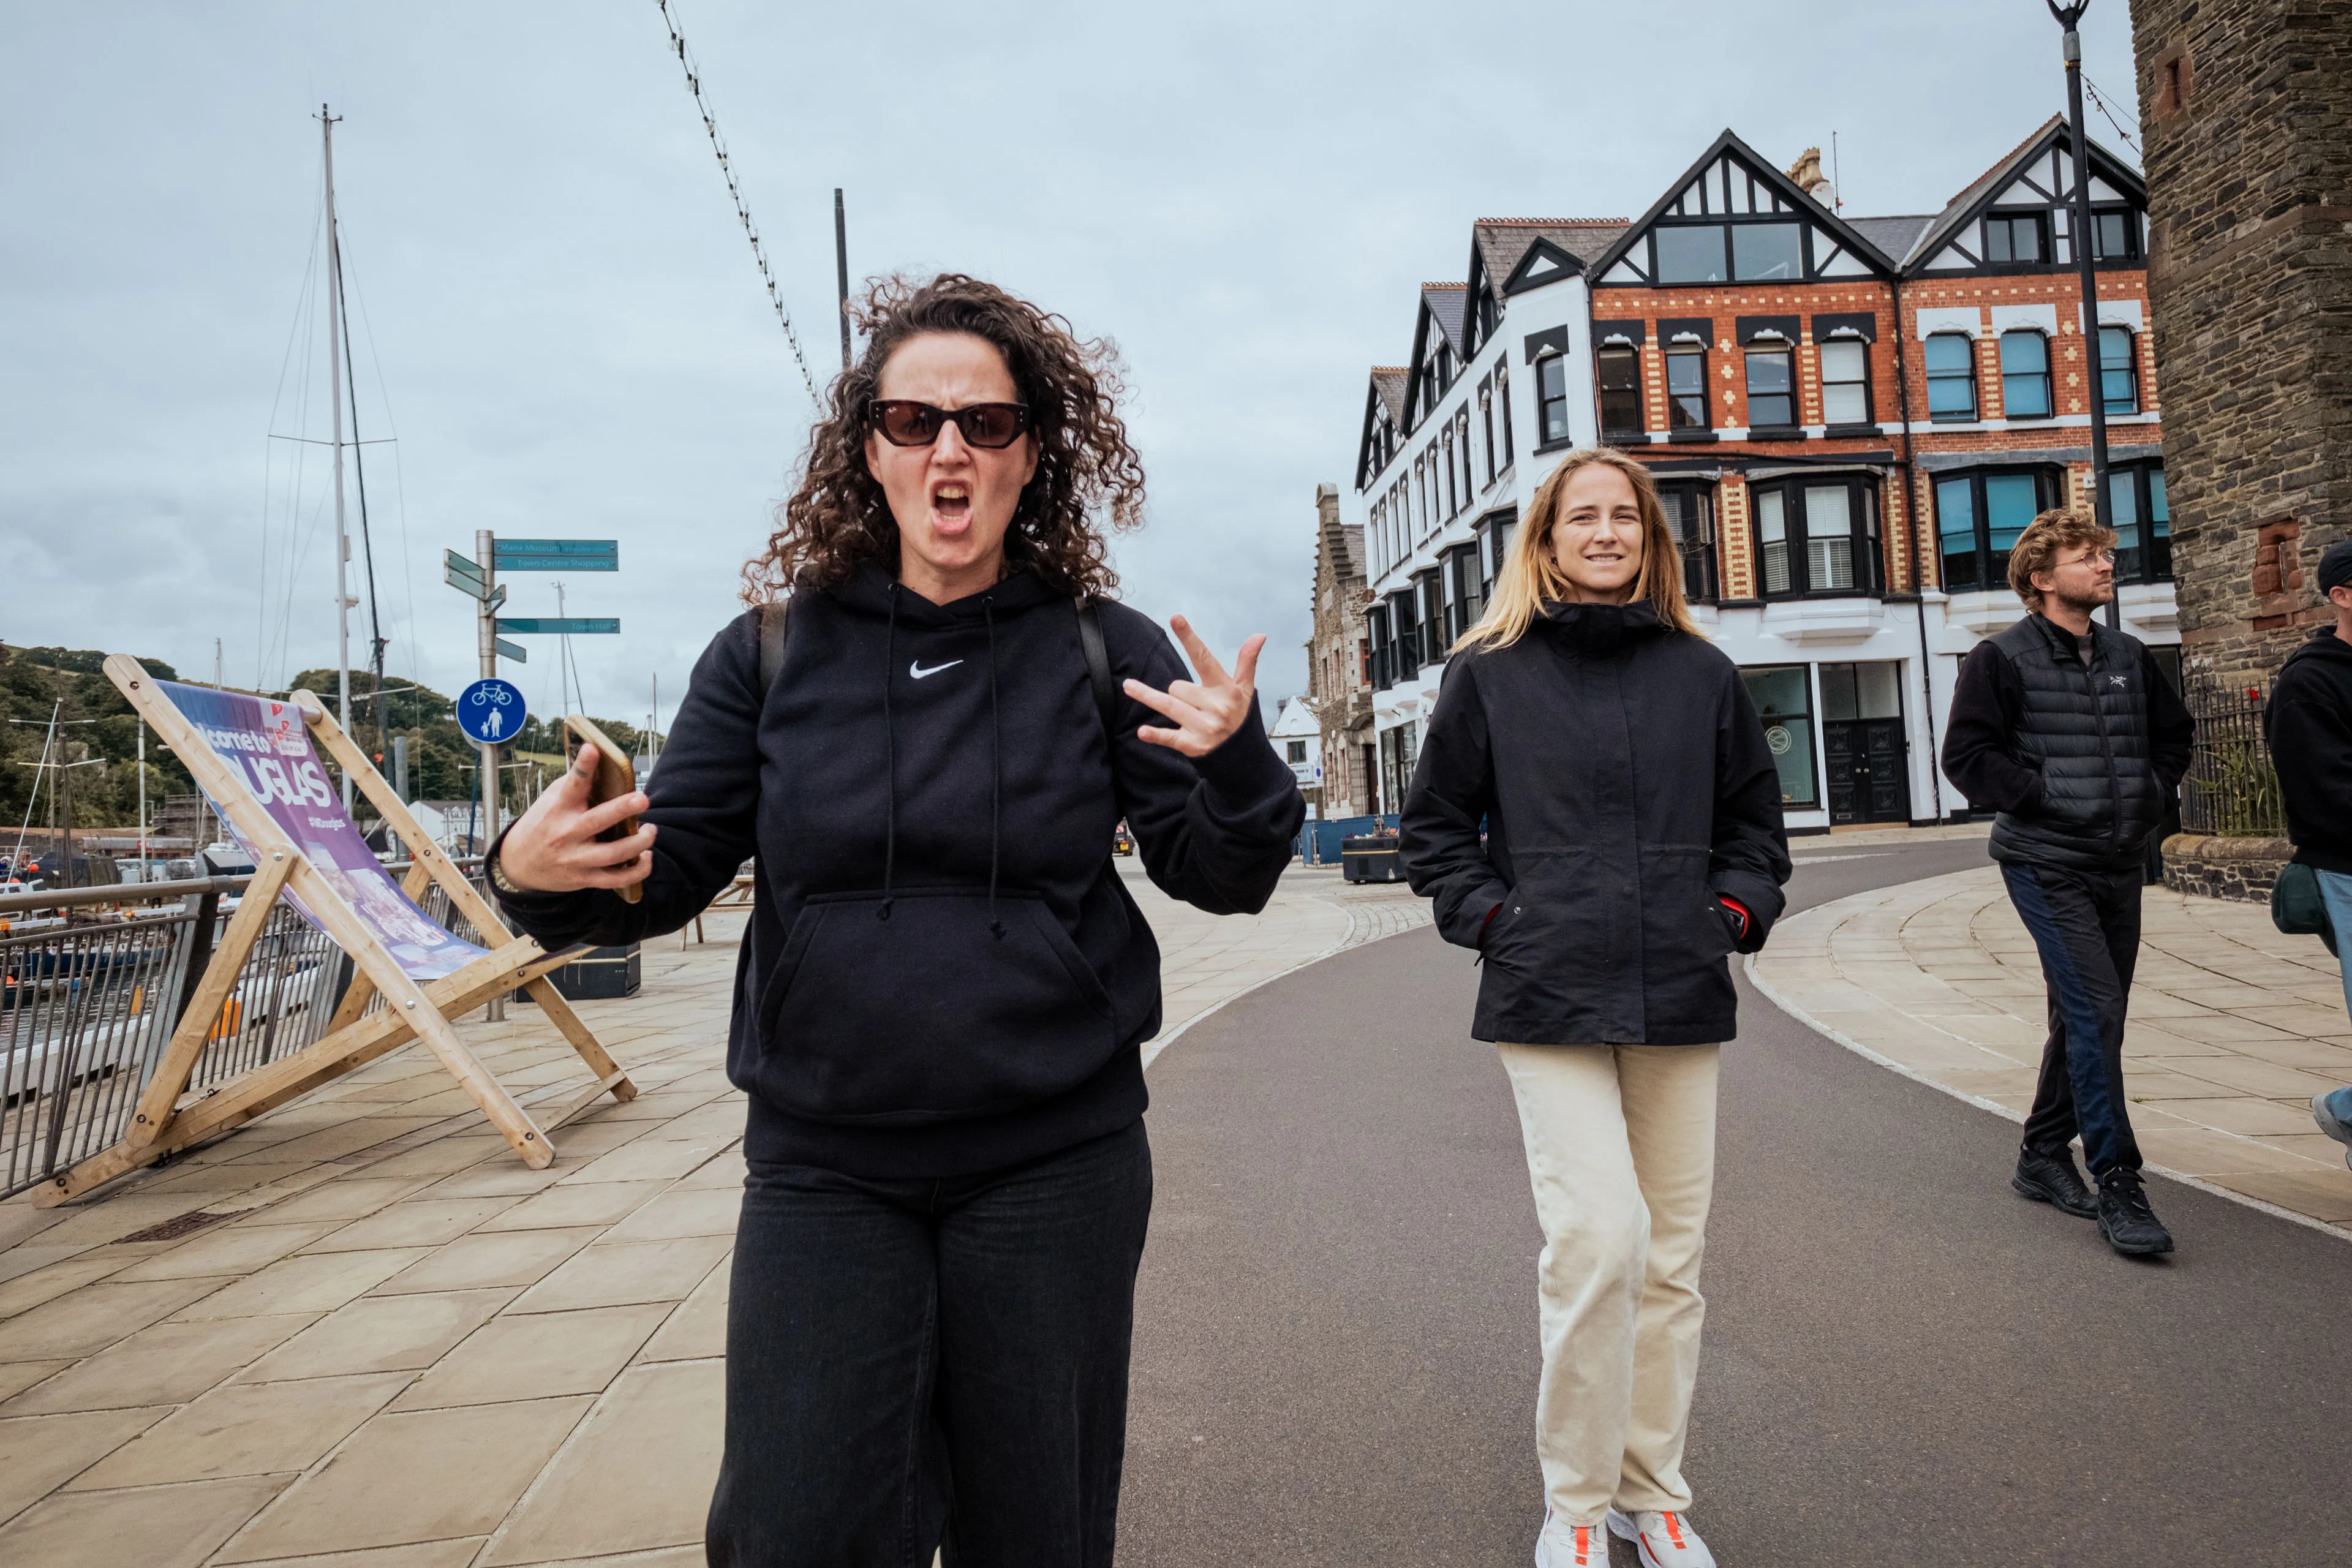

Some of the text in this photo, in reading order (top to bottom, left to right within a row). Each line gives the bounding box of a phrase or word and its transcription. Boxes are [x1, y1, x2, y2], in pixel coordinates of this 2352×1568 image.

[570, 559, 609, 569] Shopping
[595, 621, 611, 630] Hall
[194, 722, 255, 752] lcome
[216, 753, 331, 807] UGLAS
